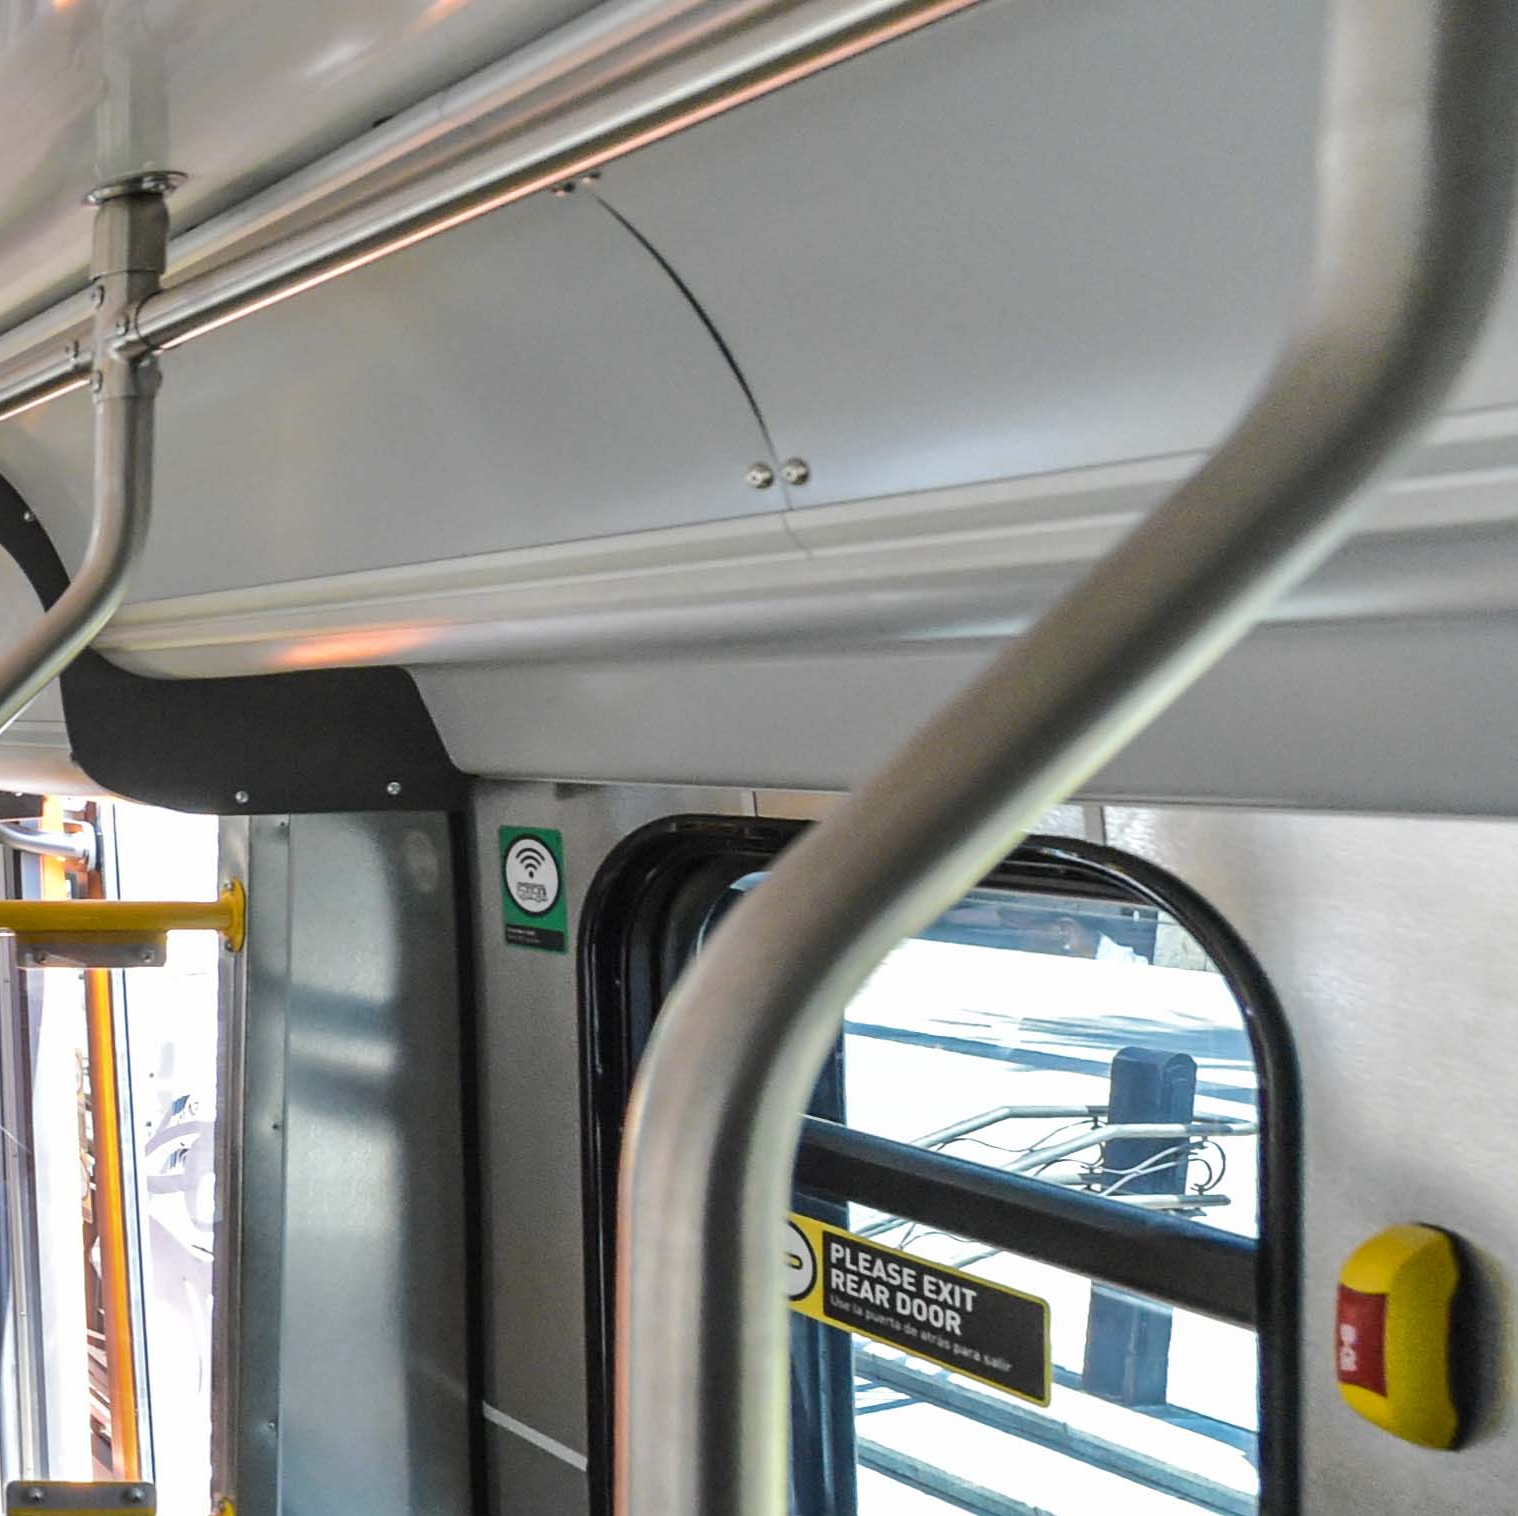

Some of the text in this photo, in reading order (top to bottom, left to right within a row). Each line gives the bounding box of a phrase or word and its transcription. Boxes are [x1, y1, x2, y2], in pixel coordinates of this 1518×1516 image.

[829, 1242, 978, 1312] PLEASE EXIT
[830, 1268, 962, 1336] REAR DOOR
